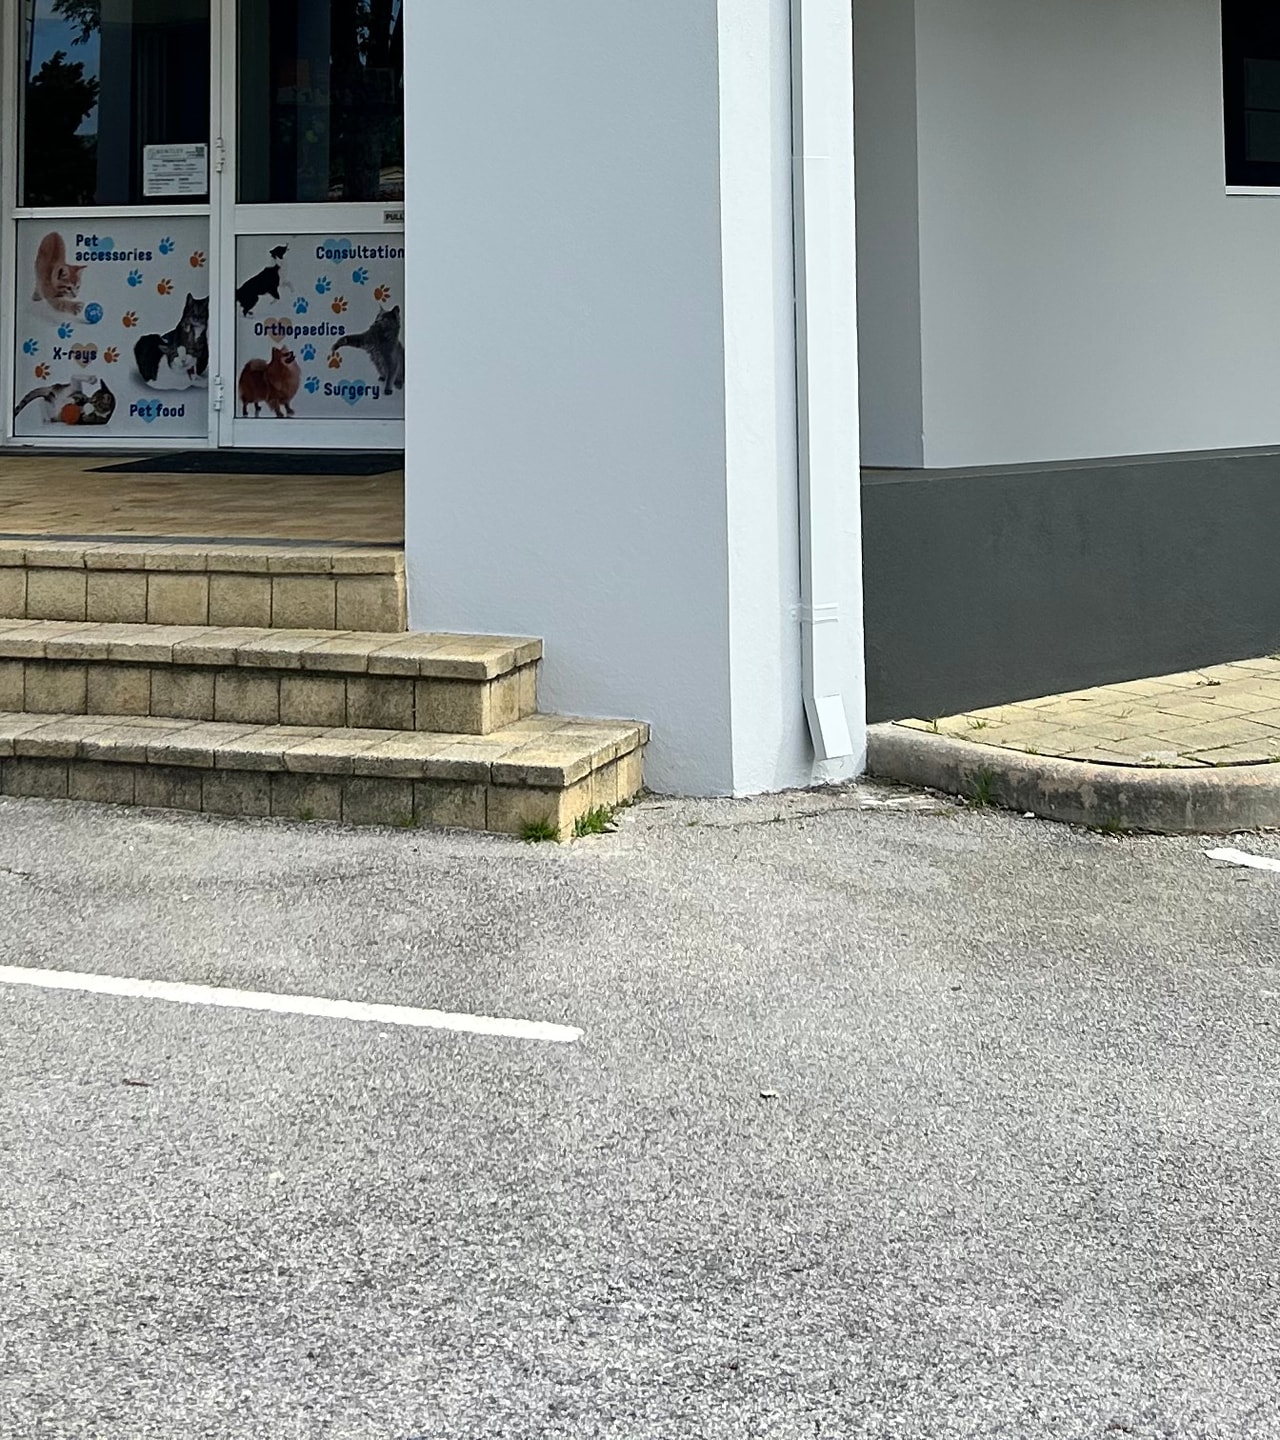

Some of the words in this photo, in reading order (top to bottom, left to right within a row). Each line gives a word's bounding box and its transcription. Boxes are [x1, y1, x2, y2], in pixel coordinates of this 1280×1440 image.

[76, 234, 99, 246] Pet
[76, 248, 152, 261] accessories
[254, 322, 345, 339] Orthopaedics
[53, 347, 97, 364] X-rays
[324, 382, 380, 399] Surgery
[130, 404, 152, 417] Pet
[156, 404, 184, 417] food
